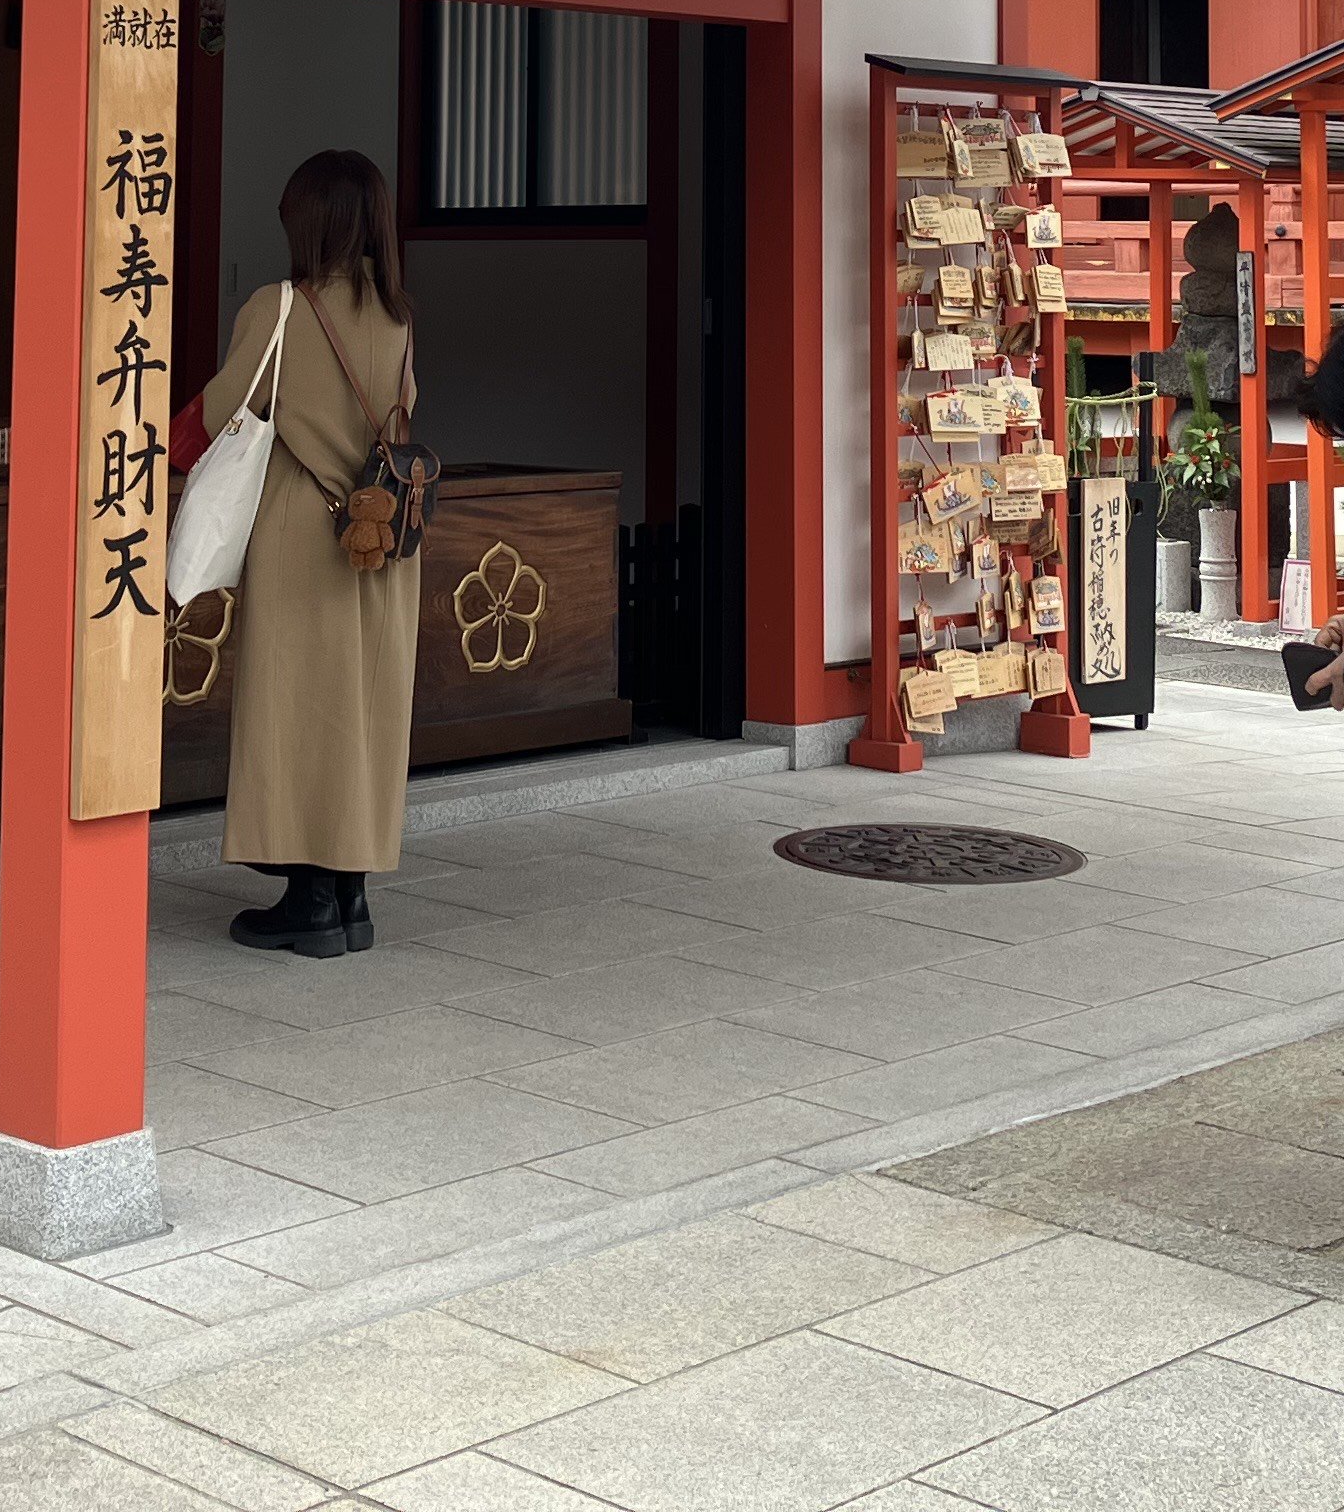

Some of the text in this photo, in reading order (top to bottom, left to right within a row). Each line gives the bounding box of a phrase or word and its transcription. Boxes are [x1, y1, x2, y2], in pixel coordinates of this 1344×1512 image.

[90, 129, 174, 620] 福寿弁財天
